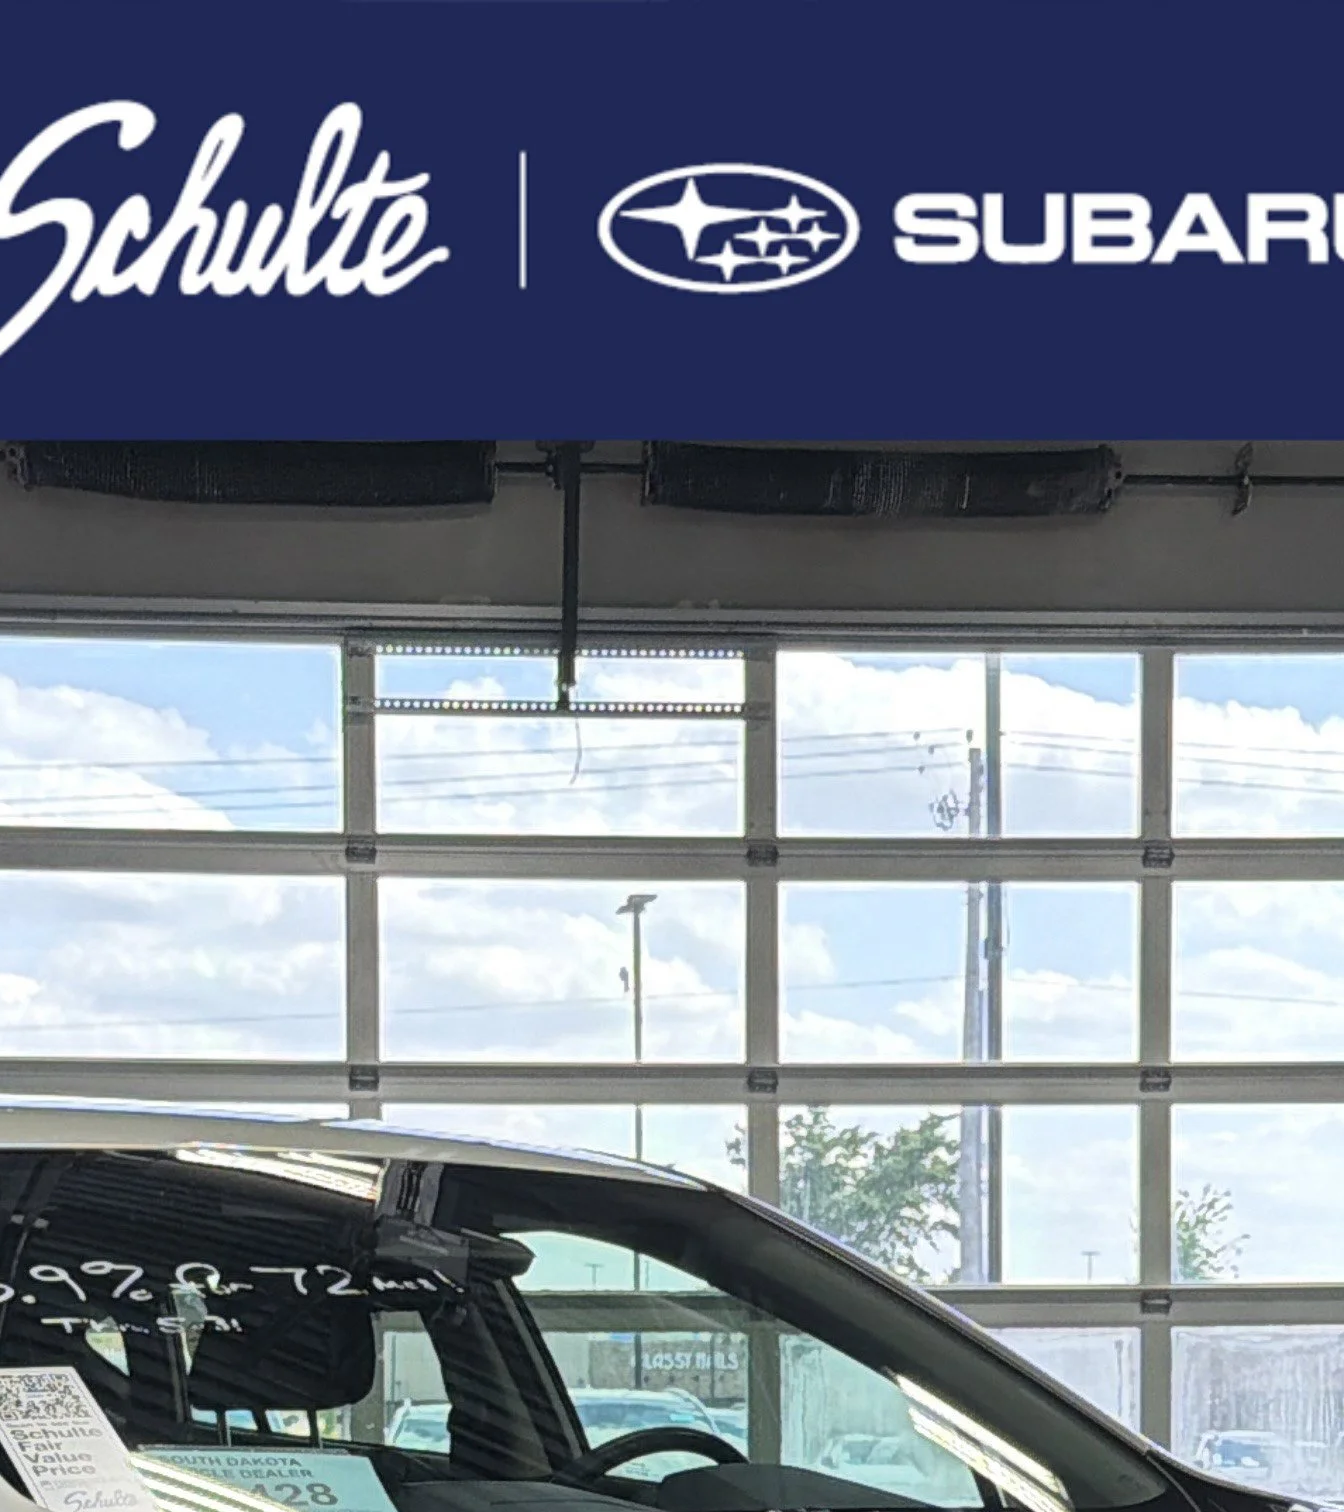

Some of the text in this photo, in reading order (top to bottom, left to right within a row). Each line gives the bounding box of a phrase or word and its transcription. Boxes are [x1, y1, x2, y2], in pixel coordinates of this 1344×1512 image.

[249, 1263, 369, 1297] 72
[9, 1426, 104, 1440] Schulte
[17, 1440, 64, 1452] Fair
[22, 1451, 93, 1464] Value
[226, 1455, 303, 1467] DAKOTA
[31, 1464, 97, 1477] Price
[239, 1468, 314, 1479] DEALER
